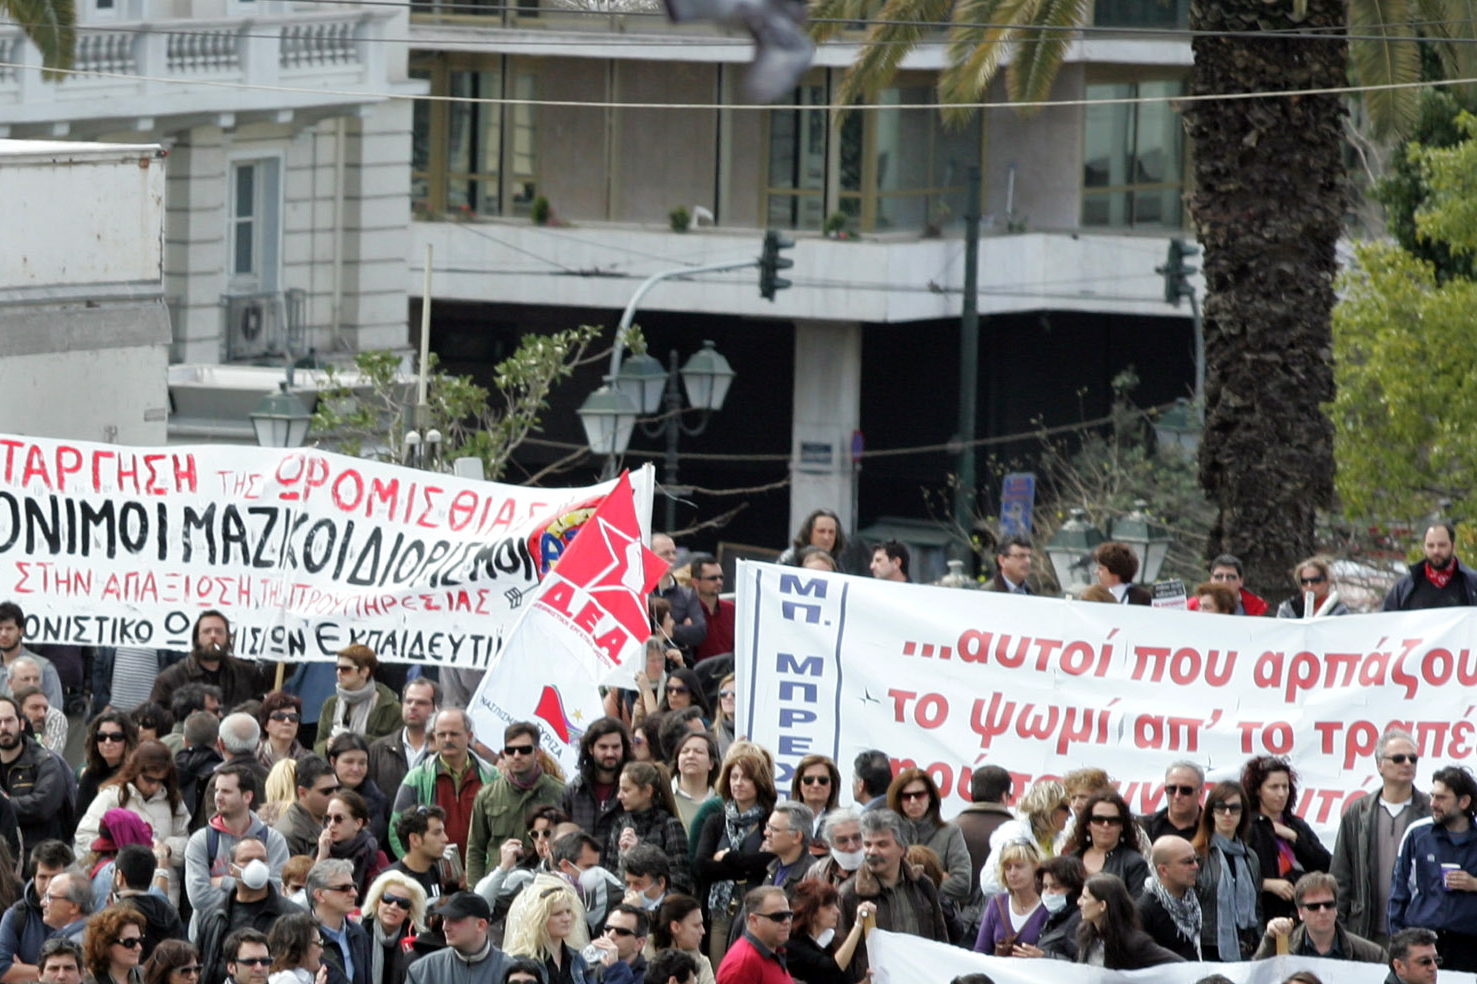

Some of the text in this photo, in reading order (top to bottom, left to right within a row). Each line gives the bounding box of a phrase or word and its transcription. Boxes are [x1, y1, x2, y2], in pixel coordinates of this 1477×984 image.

[218, 470, 262, 499] ΤΗΣ
[182, 502, 354, 580] ΜΑΖΙΚΟΙ
[348, 526, 533, 588] ΔΙΟΡΙΣΜΟΙ
[15, 561, 92, 597] ΣΤΗΝ
[101, 569, 252, 608] ΑΠΑΞΙΩΣΗ
[1131, 645, 1237, 687] που
[888, 688, 949, 730] το
[970, 692, 1121, 755] ψωμί
[1237, 721, 1294, 755] το
